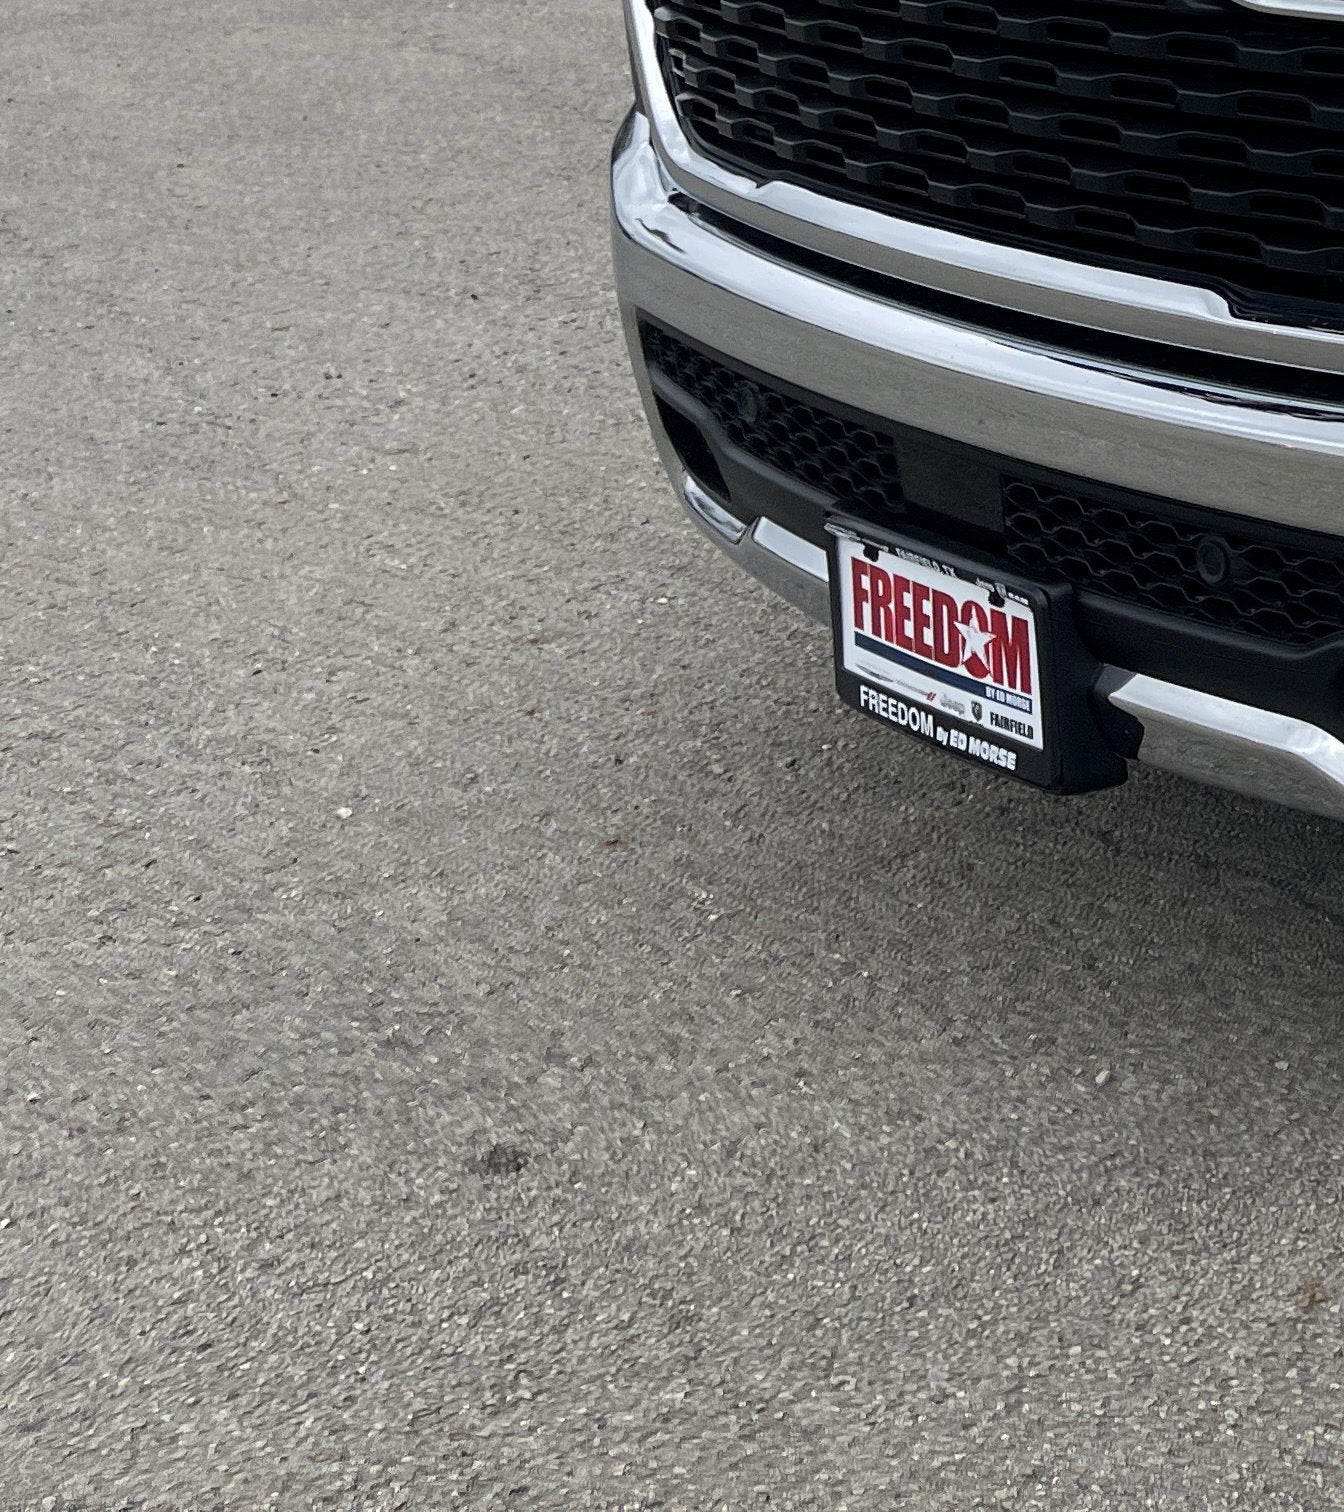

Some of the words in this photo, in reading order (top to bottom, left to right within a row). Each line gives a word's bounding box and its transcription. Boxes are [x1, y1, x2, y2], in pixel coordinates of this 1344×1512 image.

[851, 556, 1032, 695] FREEDOM
[859, 685, 934, 738] FREEDOM
[950, 729, 968, 752] ED
[968, 735, 1017, 771] MORSE
[989, 711, 1034, 740] FAIRFIELD
